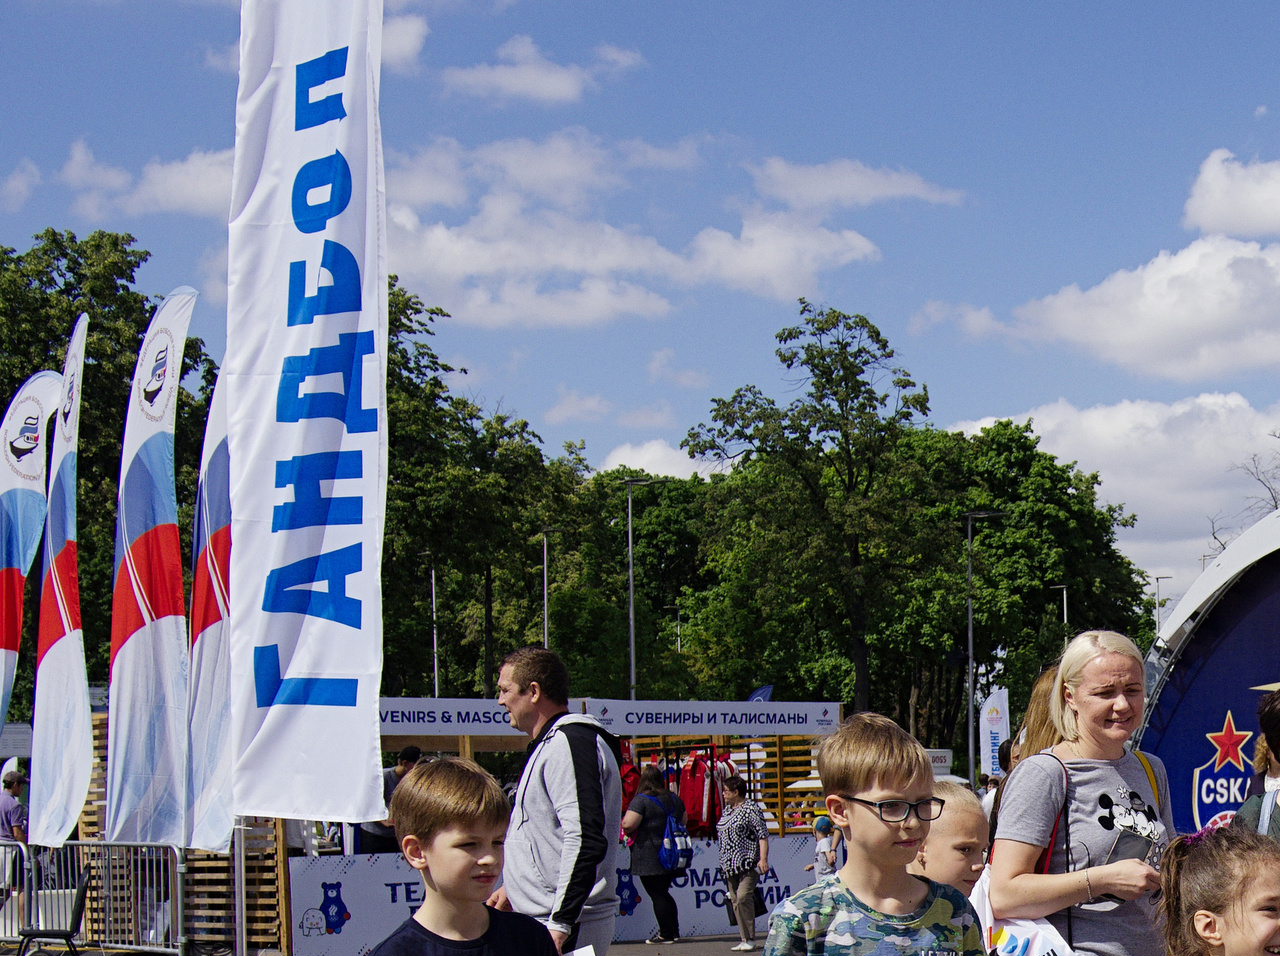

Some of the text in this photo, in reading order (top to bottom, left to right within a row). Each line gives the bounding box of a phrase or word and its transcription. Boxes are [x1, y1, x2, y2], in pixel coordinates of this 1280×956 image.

[253, 45, 379, 708] ГАНДБОЛ
[440, 710, 453, 724] &
[625, 711, 703, 724] СУВЕНИРЫ
[707, 712, 717, 724] И
[720, 712, 808, 725] ТАЛИСМАНЫ
[384, 881, 426, 903] TE
[694, 885, 792, 909] РОИИ
